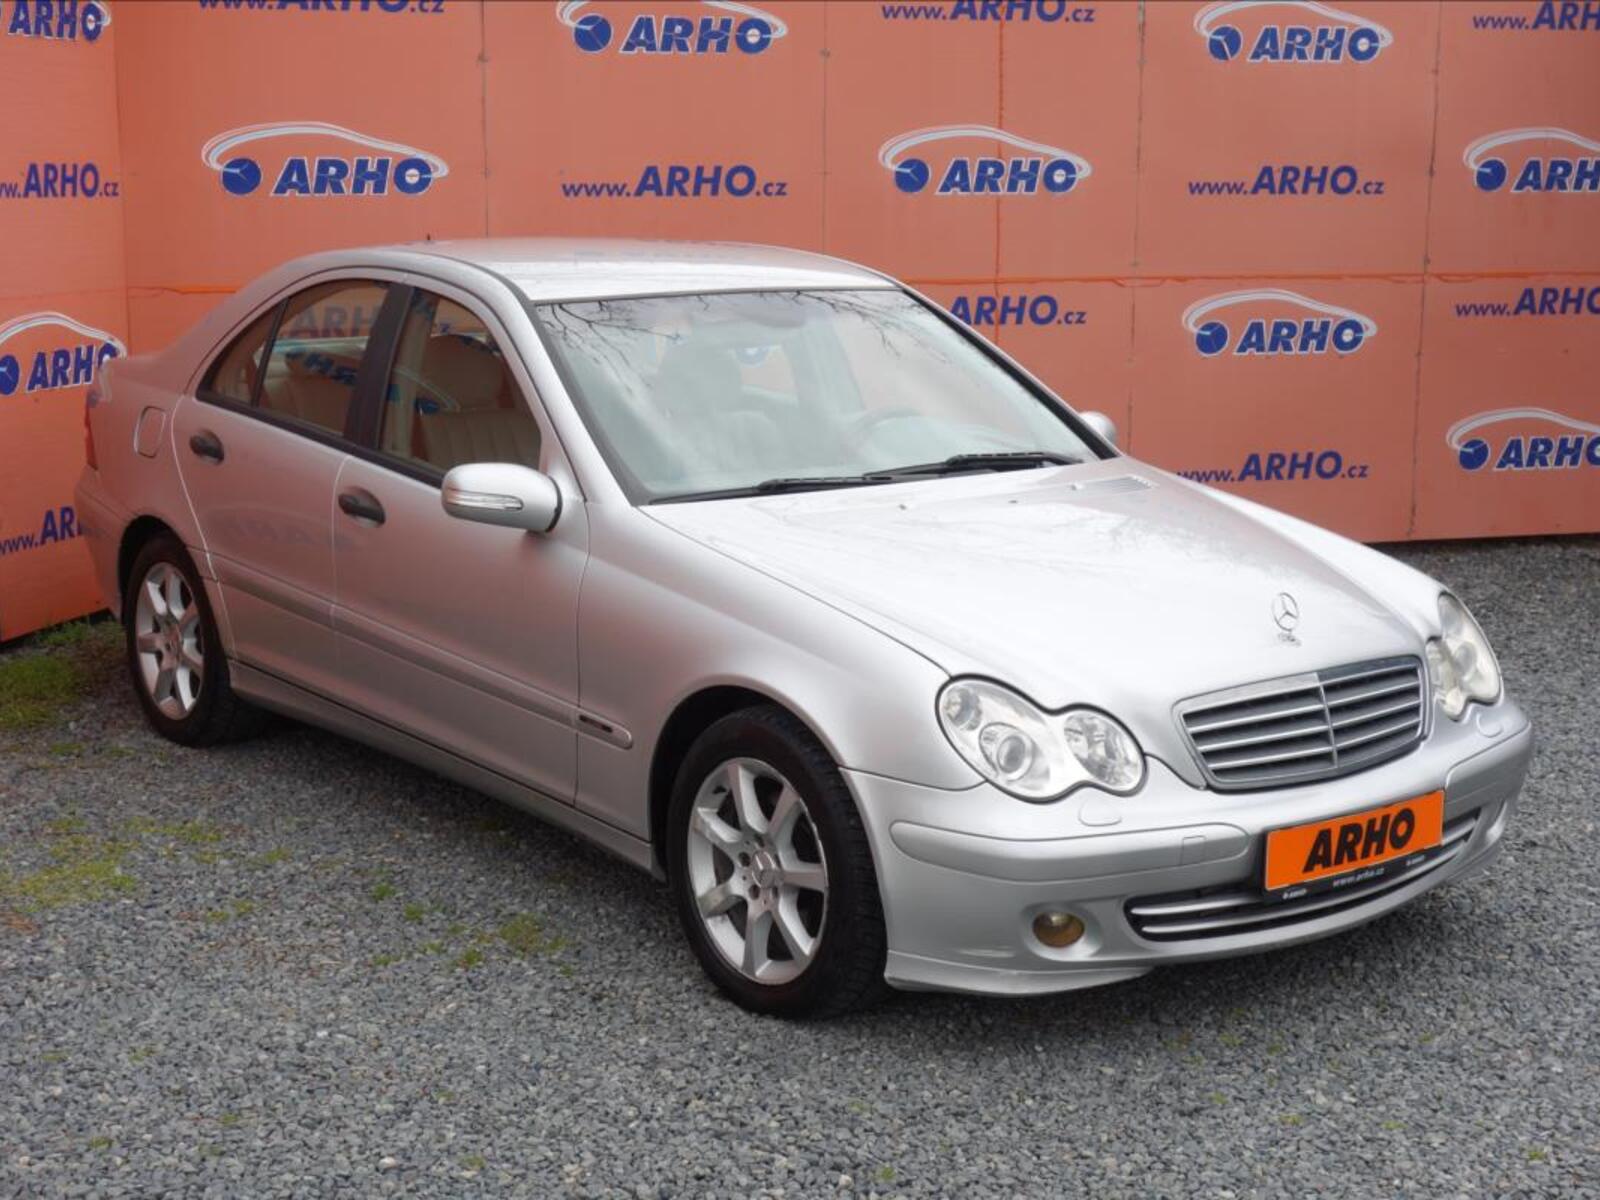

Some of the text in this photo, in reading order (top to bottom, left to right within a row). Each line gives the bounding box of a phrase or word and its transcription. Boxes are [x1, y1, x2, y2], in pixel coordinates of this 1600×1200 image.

[8, 0, 103, 41] ARHO
[622, 16, 772, 53] ARHO
[1249, 26, 1380, 61] ARHO
[273, 157, 433, 195] ARHO
[562, 165, 787, 197] www.ARHO.cz
[938, 158, 1077, 193] ARHO
[1188, 165, 1384, 195] www.ARHO.cz
[1234, 318, 1364, 354] ARHO
[1303, 807, 1415, 873] ARHO
